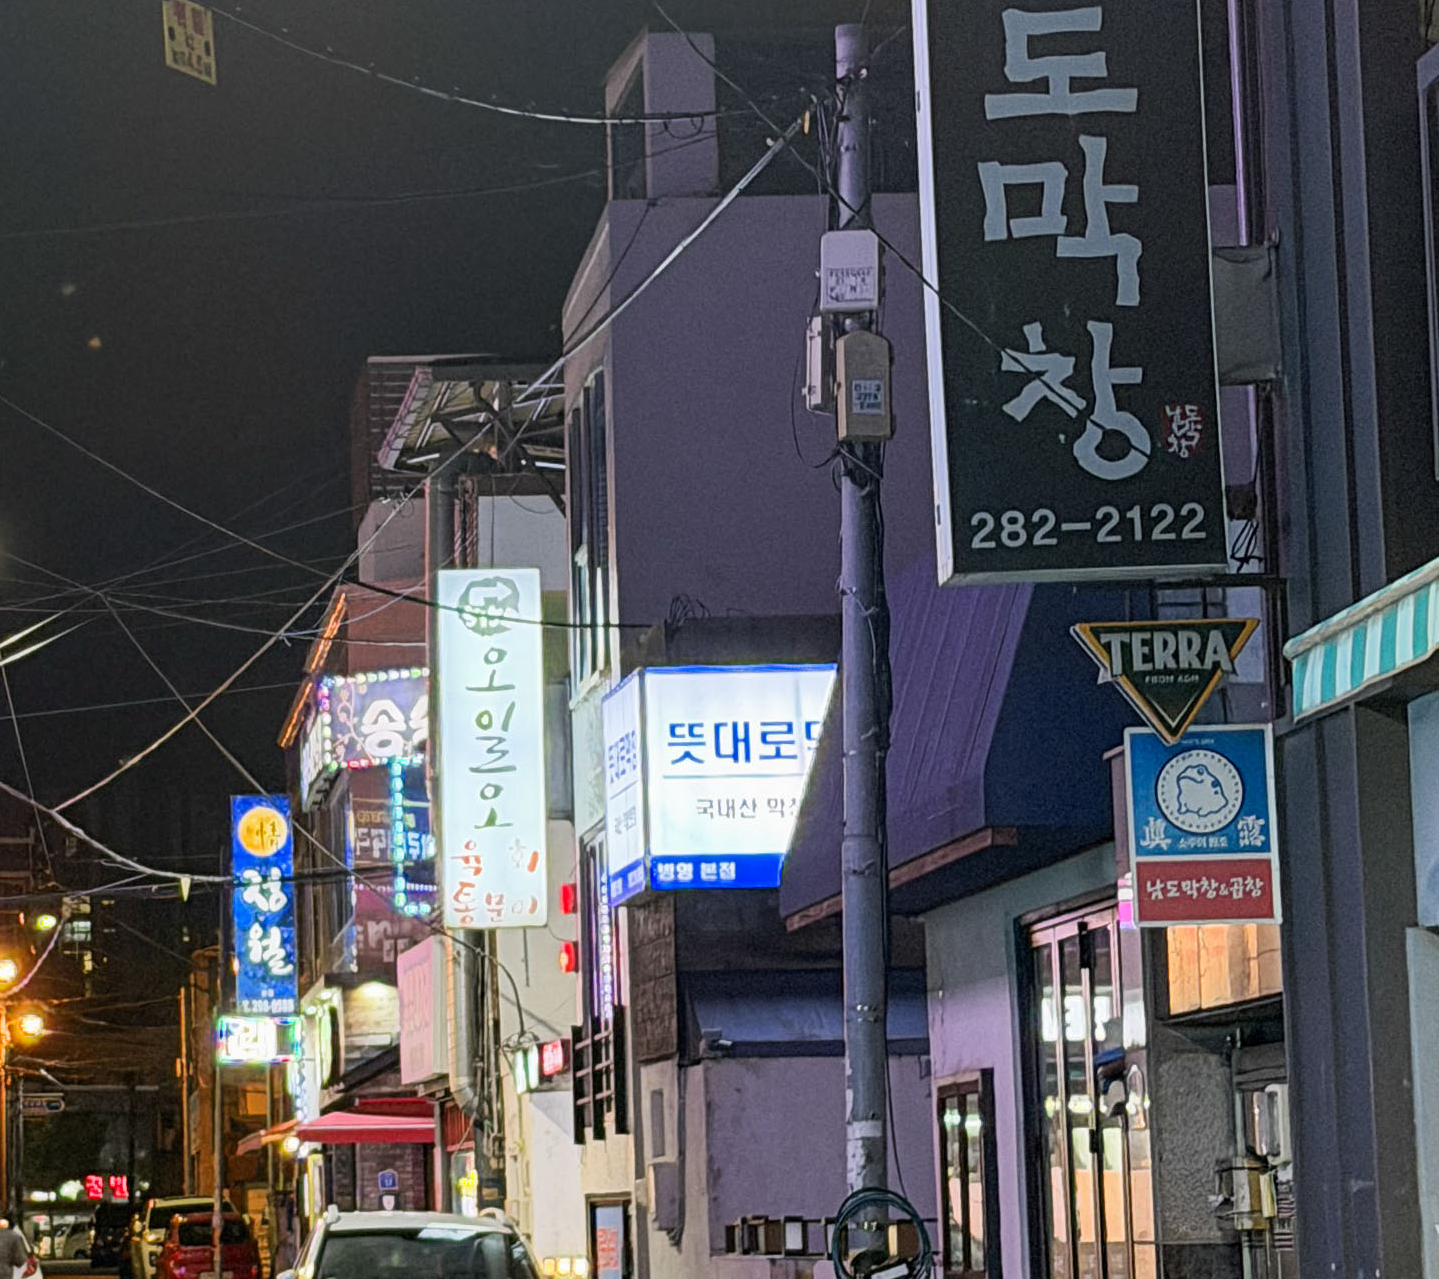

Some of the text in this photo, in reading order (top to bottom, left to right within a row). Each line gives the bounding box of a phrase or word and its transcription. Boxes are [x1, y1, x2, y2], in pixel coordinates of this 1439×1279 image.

[969, 501, 1208, 550] 282-2122
[1099, 628, 1237, 677] TERRA
[464, 645, 518, 831] 오일오
[696, 797, 758, 820] 국내산
[1145, 875, 1265, 901] 남도막창&곱창
